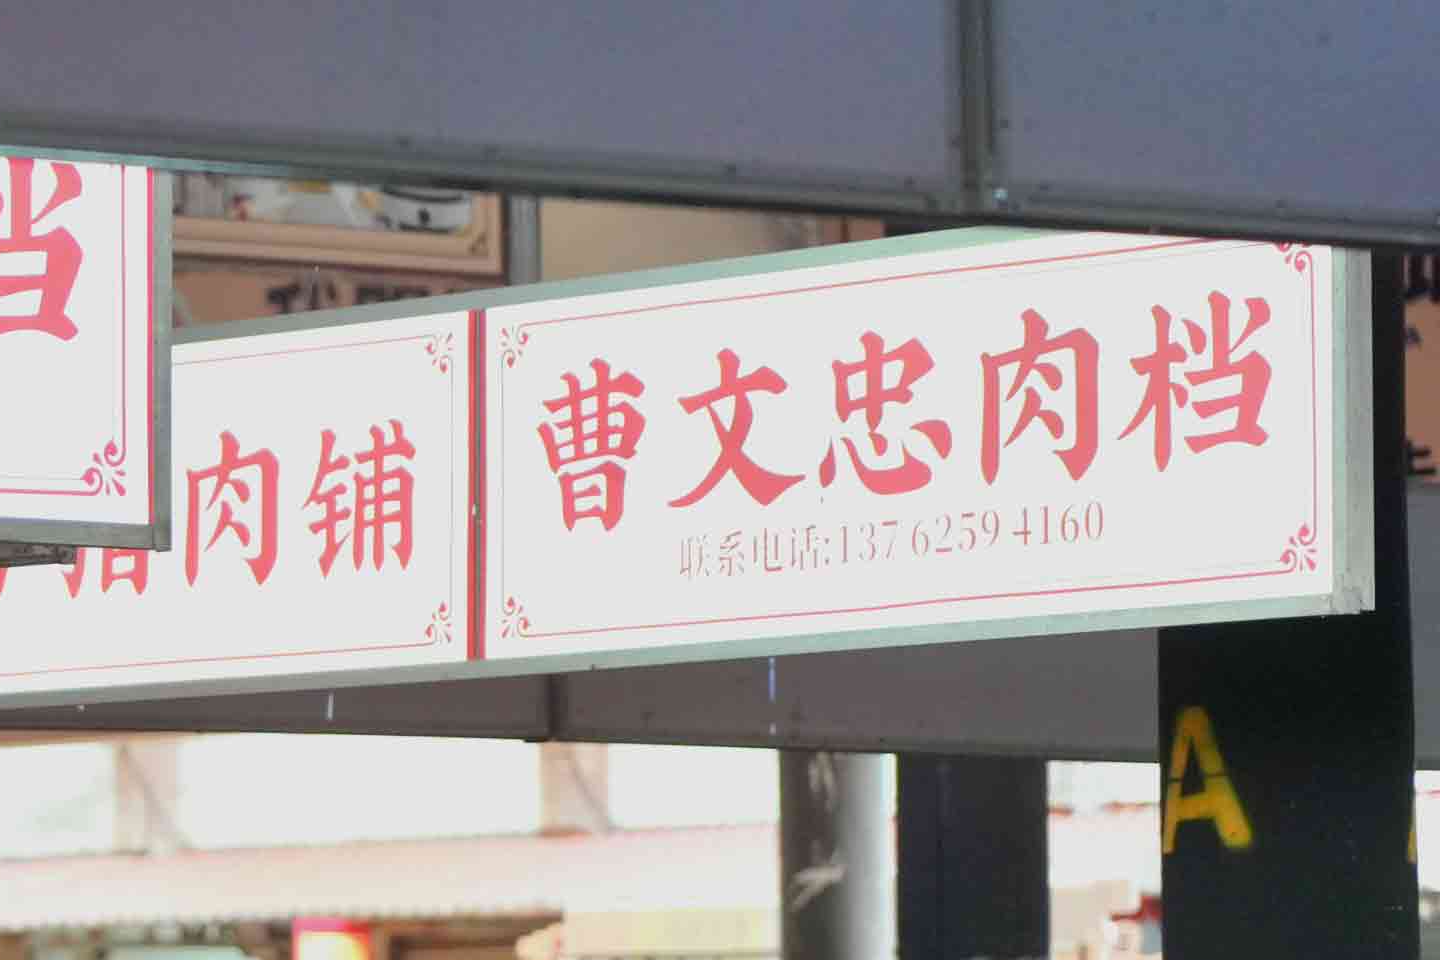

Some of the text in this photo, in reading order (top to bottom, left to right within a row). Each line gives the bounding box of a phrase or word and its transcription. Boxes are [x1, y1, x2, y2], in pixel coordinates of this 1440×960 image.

[538, 291, 1273, 532] 曹文忠肉档
[1161, 706, 1253, 854] A
